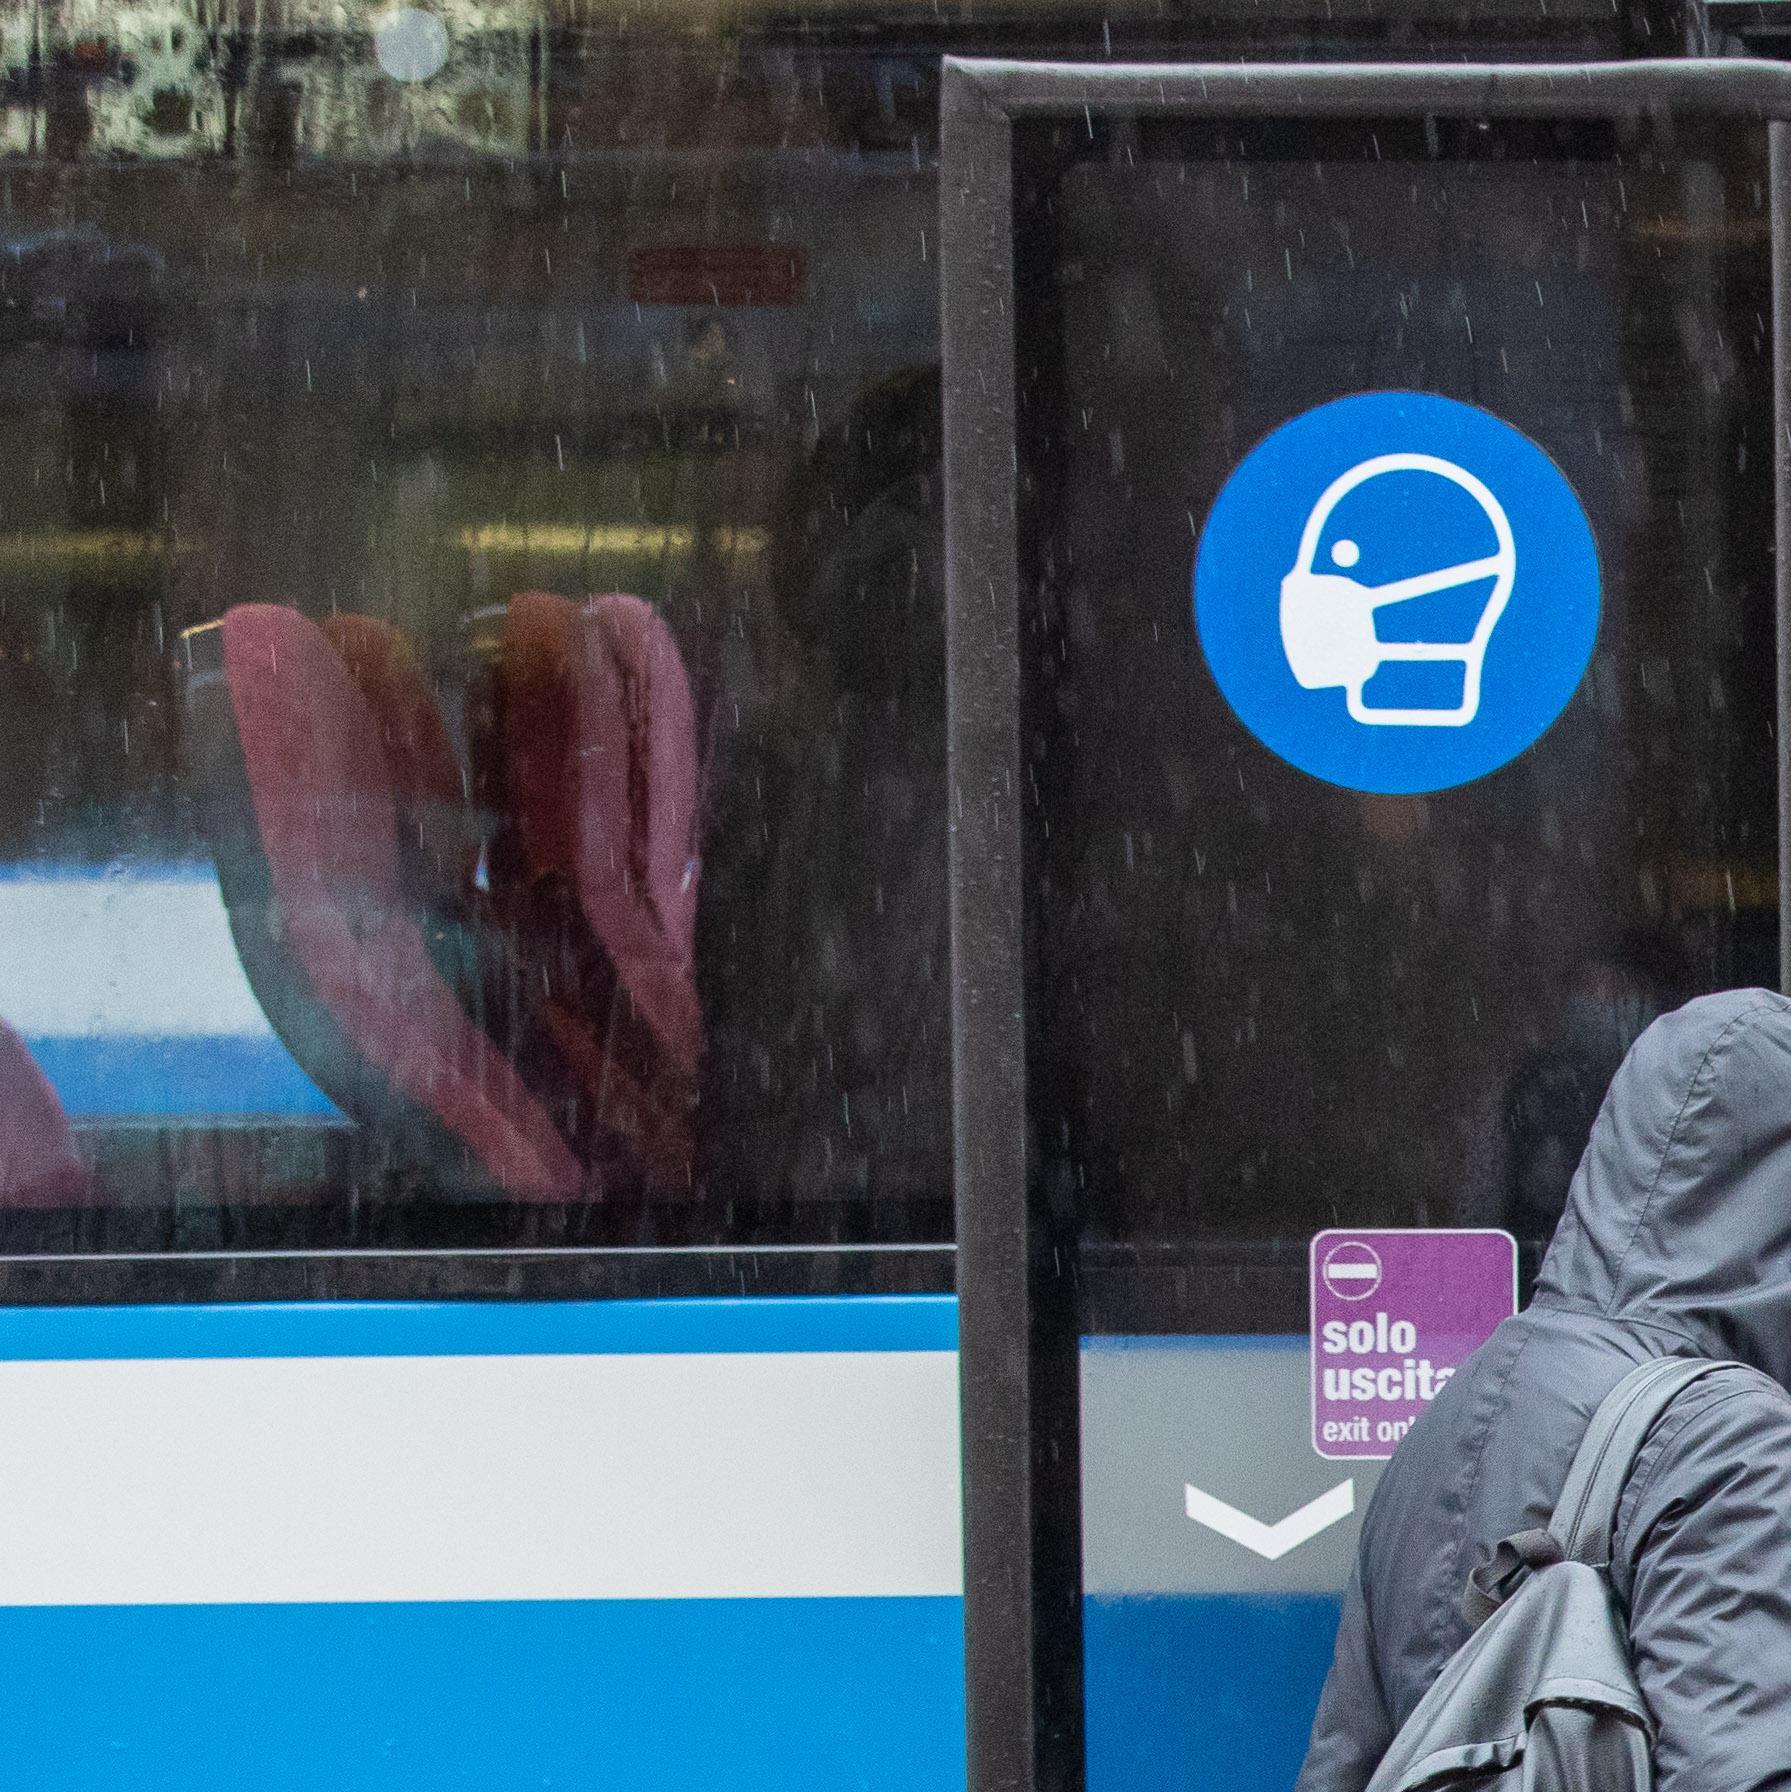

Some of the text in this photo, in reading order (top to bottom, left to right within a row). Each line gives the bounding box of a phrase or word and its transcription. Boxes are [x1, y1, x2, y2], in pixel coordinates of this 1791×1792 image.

[1322, 1312, 1417, 1354] solo
[1322, 1416, 1417, 1442] exit on
